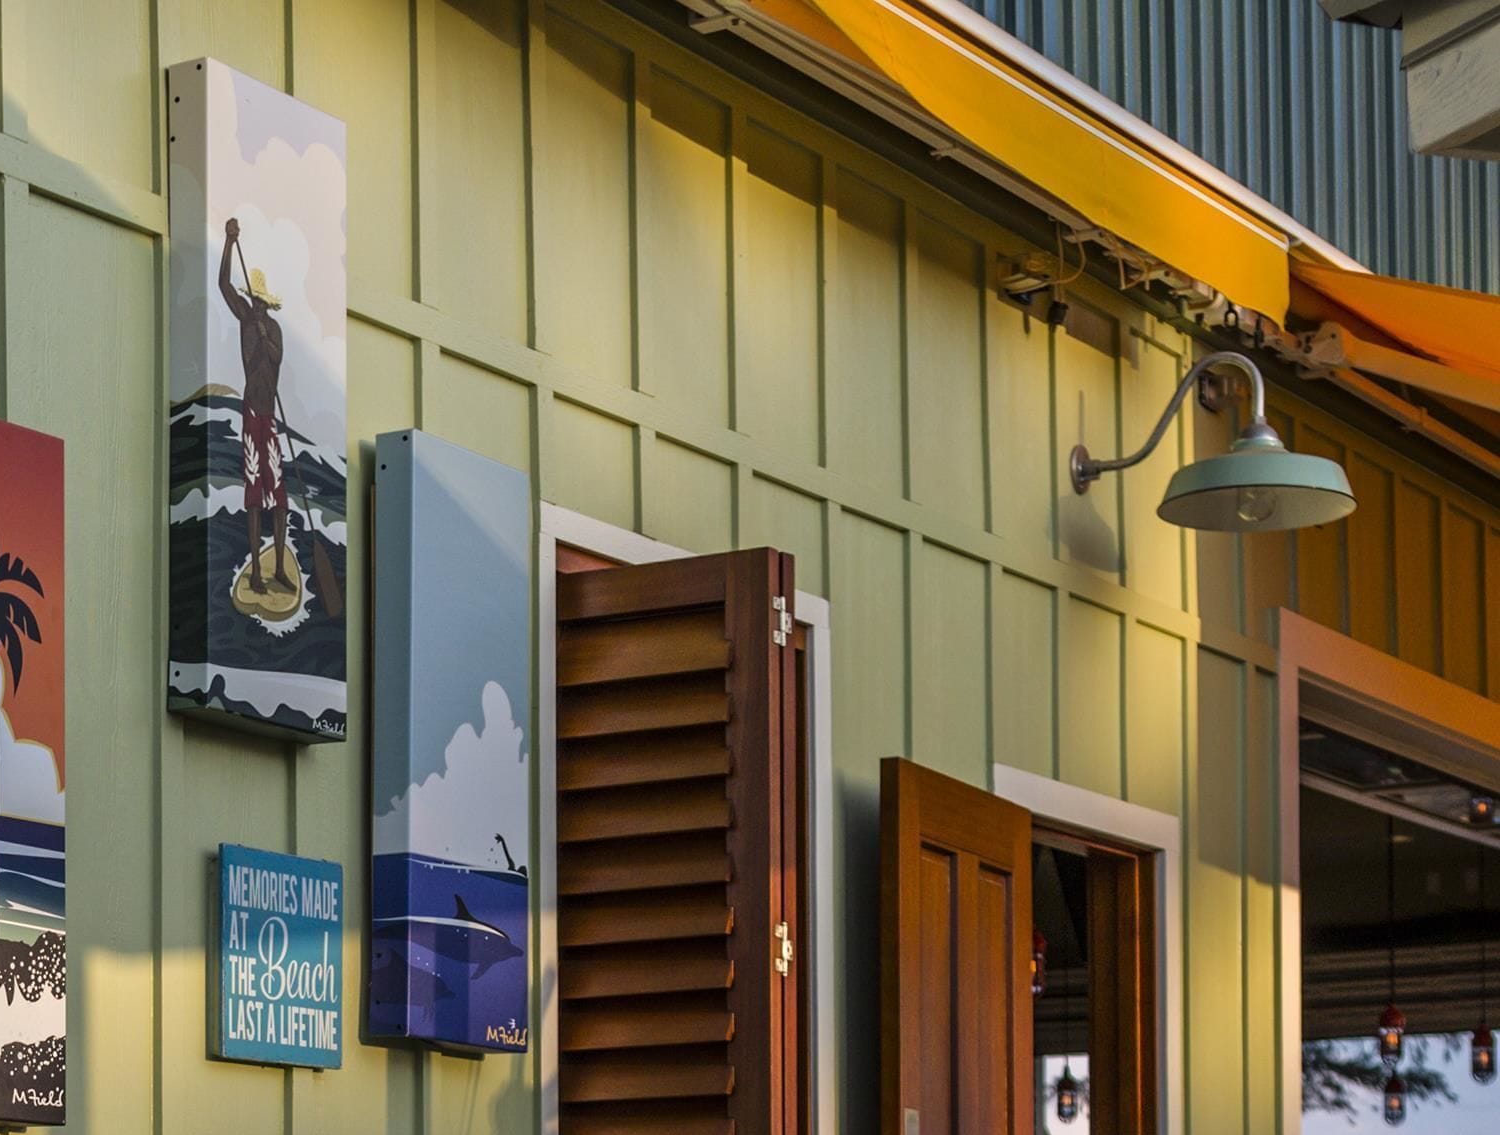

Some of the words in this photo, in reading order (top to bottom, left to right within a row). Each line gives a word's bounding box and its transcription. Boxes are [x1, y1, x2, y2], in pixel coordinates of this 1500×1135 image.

[228, 864, 298, 916] MEMORIES
[301, 876, 339, 922] MADE
[229, 910, 249, 950] AT
[228, 955, 257, 997] THE
[258, 916, 339, 1004] Beach
[228, 998, 263, 1042] LAST
[266, 1003, 277, 1044] A
[280, 1005, 339, 1051] LIFETIME
